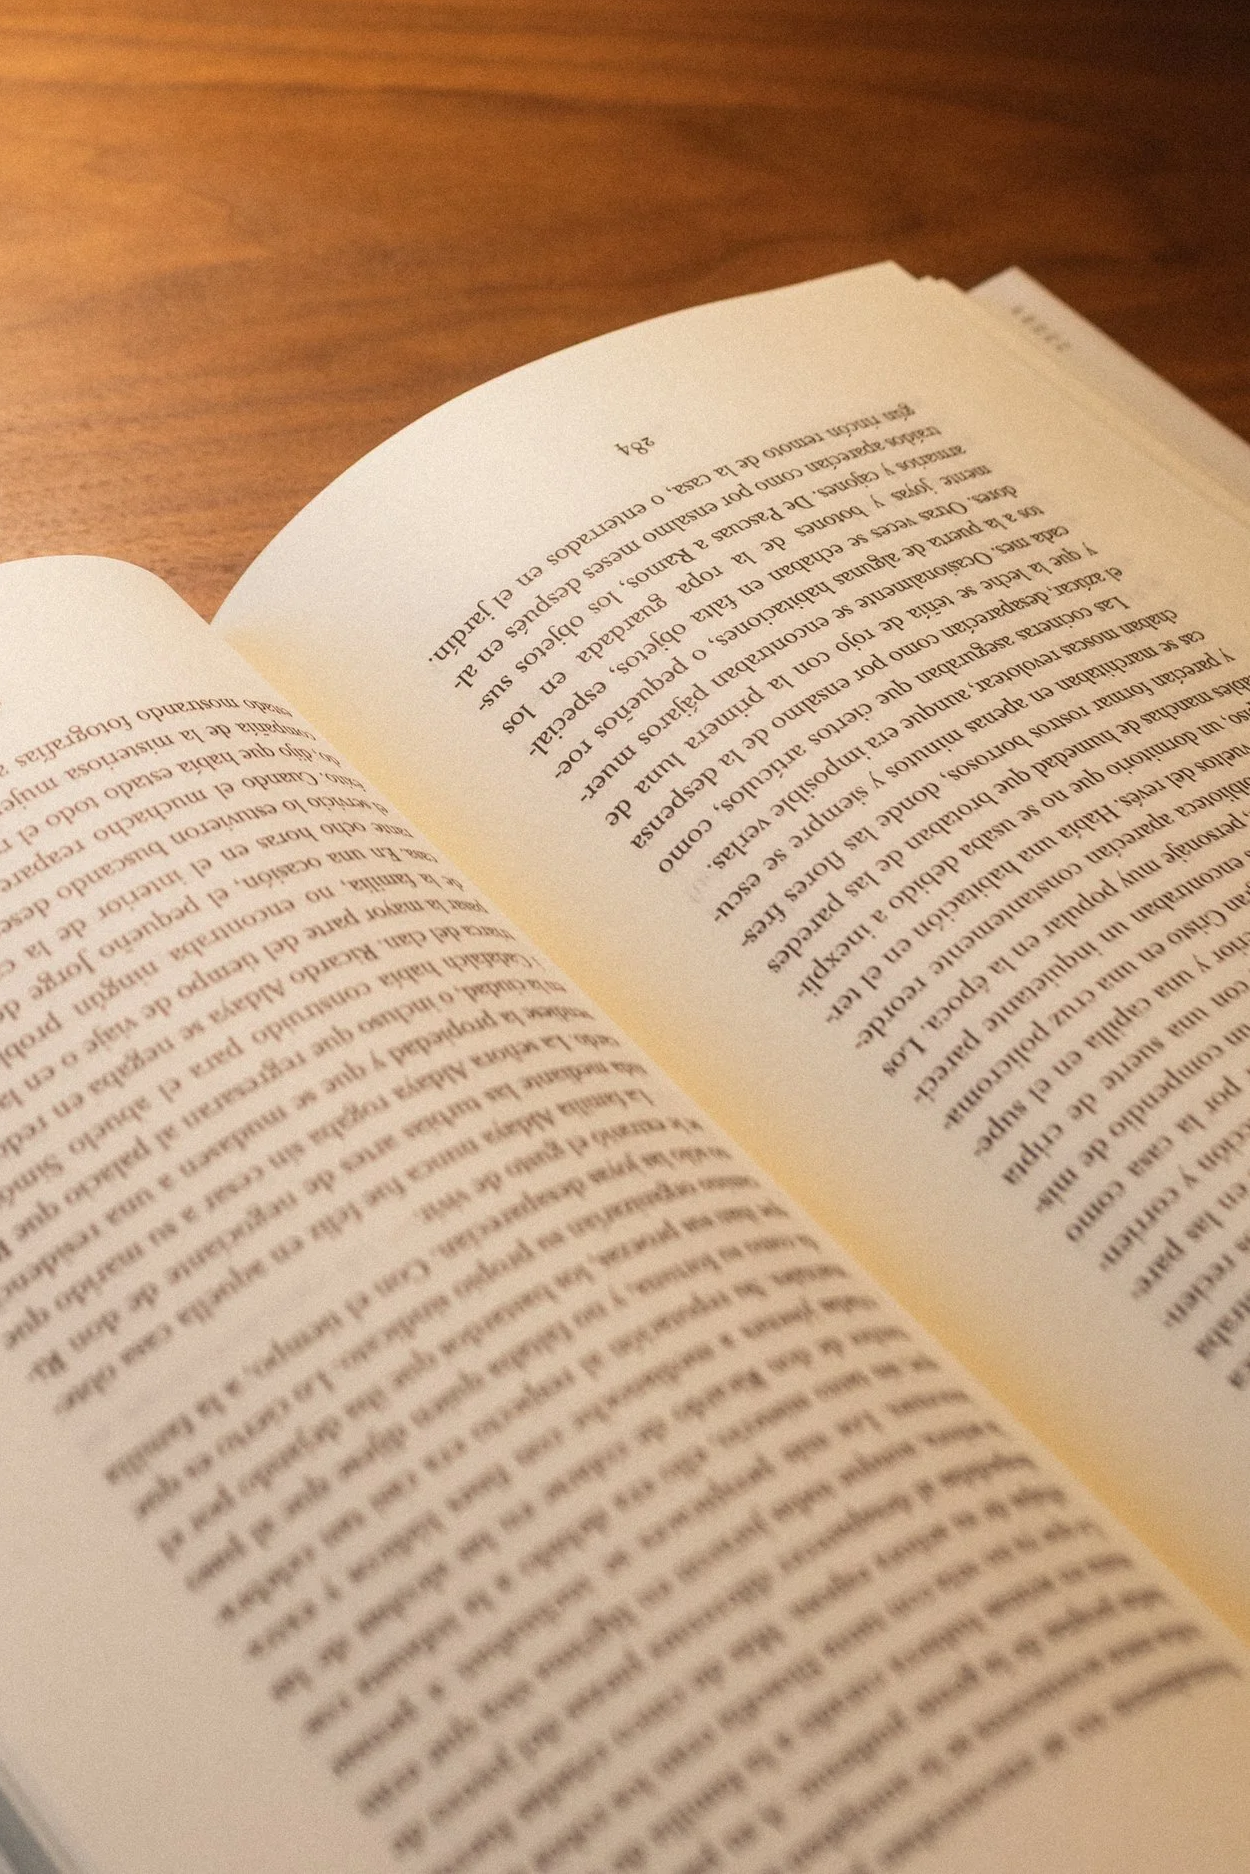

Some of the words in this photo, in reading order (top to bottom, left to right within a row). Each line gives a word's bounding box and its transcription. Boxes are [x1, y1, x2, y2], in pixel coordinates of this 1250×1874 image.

[881, 403, 916, 422] gún
[825, 415, 882, 438] rincón
[883, 425, 943, 448] traídos
[614, 436, 655, 456] 284
[761, 432, 826, 459] remoto
[803, 439, 886, 473] aparecían
[712, 464, 739, 478] la
[734, 455, 760, 469] de
[754, 468, 804, 491] como
[938, 464, 993, 486] mente
[650, 494, 666, 505] o
[720, 482, 755, 507] por
[869, 493, 887, 509] y
[890, 477, 938, 502] joyas
[642, 502, 719, 543] ensalmo
[793, 505, 870, 538] botones
[917, 501, 968, 522] Otras
[546, 503, 647, 566] enterrados
[846, 533, 869, 547] se
[869, 517, 919, 539] veces
[1029, 525, 1070, 545] cada
[760, 536, 787, 552] de
[1081, 541, 1099, 557] y
[582, 539, 642, 579] meses
[730, 551, 758, 565] la
[767, 544, 844, 581] echaban
[1026, 561, 1053, 575] la
[1048, 547, 1082, 567] que
[515, 566, 543, 587] en
[675, 565, 724, 594] ropa
[737, 579, 765, 596] en
[854, 551, 994, 609] Ocasionalmente
[979, 568, 1033, 591] leche
[491, 588, 513, 610] el
[955, 585, 978, 599] se
[1093, 595, 1131, 613] Las
[504, 577, 582, 639] después
[689, 594, 738, 623] falta
[831, 604, 855, 620] se
[905, 595, 955, 620] teñía
[575, 593, 668, 664] guardada
[878, 616, 905, 632] de
[1014, 606, 1093, 641] cocineras
[1117, 609, 1178, 635] chaban
[476, 639, 504, 663] en
[710, 616, 830, 688] encontraban
[835, 628, 876, 653] rojo
[1059, 628, 1122, 656] moscas
[791, 651, 831, 675] con
[914, 635, 1016, 684] aseguraban
[538, 671, 567, 695] en
[766, 674, 795, 690] la
[875, 679, 913, 705] que
[135, 698, 241, 723] mostrando
[502, 703, 537, 735] los
[637, 682, 710, 746] pájaros
[683, 685, 766, 750] primera
[899, 688, 972, 729] aunque
[178, 728, 206, 744] la
[205, 724, 232, 739] de
[234, 719, 317, 741] compañía
[807, 703, 873, 746] ciertos
[14, 715, 133, 768] fotografías
[864, 726, 899, 749] era
[63, 734, 175, 781] misteriosa
[238, 742, 276, 760] que
[278, 742, 313, 763] dijo
[176, 751, 241, 776] había
[633, 751, 687, 794] luna
[103, 767, 174, 800] estado
[241, 771, 319, 791] Cuando
[770, 746, 872, 817] imposible
[1164, 767, 1197, 789] del
[213, 782, 235, 800] el
[44, 796, 100, 827] todo
[92, 789, 209, 841] muchacho
[281, 798, 309, 814] lo
[306, 796, 372, 812] servicio
[370, 801, 389, 817] el
[605, 799, 632, 827] de
[169, 803, 278, 845] estuvieron
[1055, 804, 1121, 839] Había
[15, 824, 40, 847] el
[658, 819, 713, 874] como
[325, 848, 367, 864] una
[369, 847, 403, 863] En
[1016, 836, 1059, 863] una
[55, 840, 170, 900] buscando
[206, 887, 230, 909] el
[912, 859, 1024, 938] habitación
[98, 894, 202, 959] pequeño
[882, 938, 912, 964] en
[30, 948, 97, 1001] Jorge
[859, 965, 882, 991] el
